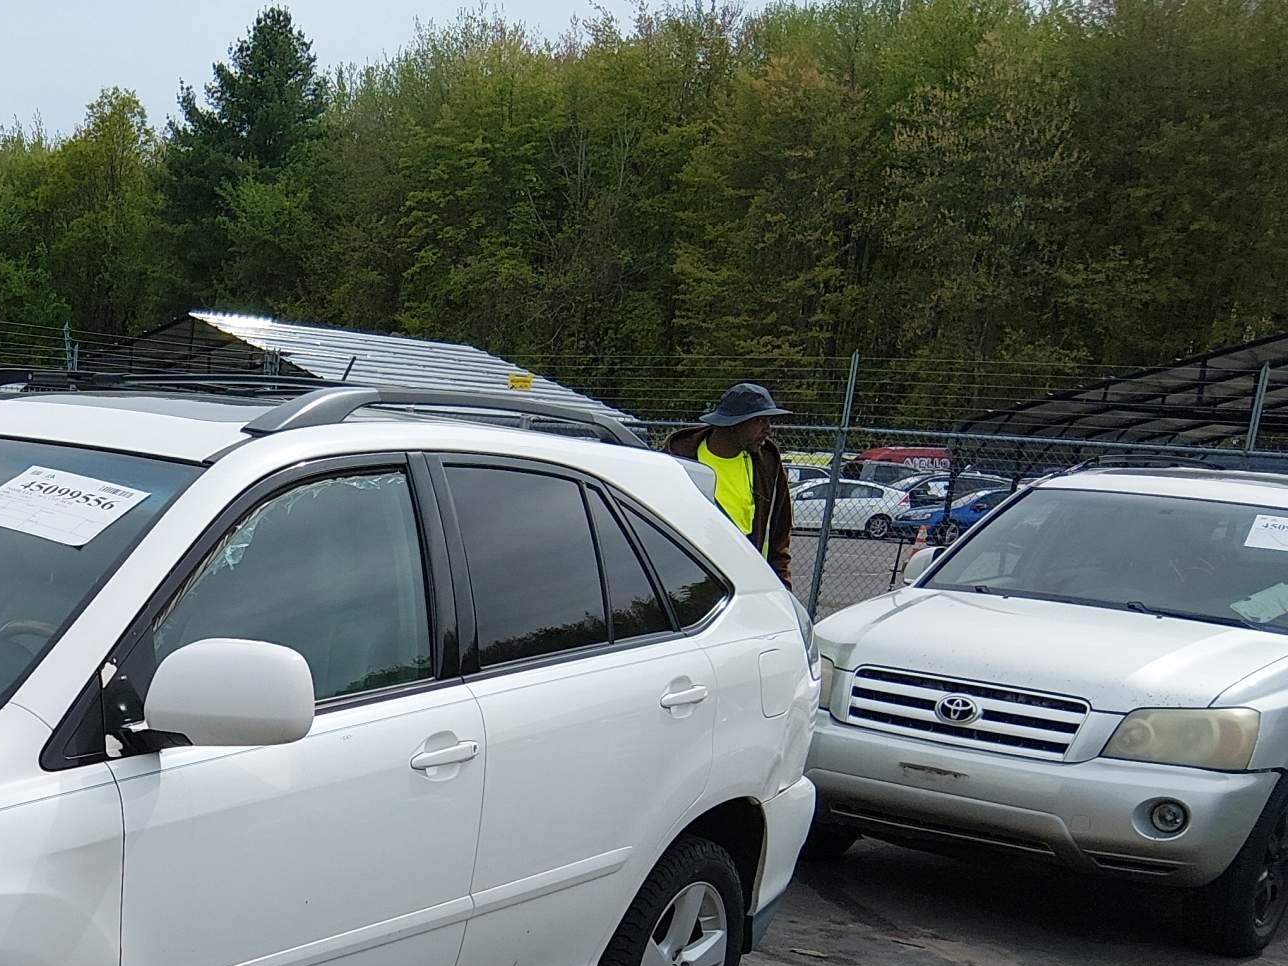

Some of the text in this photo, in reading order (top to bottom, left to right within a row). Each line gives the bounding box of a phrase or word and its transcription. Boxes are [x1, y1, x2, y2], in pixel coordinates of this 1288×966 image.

[904, 457, 951, 469] AIELLO
[19, 481, 121, 510] 45099556
[1261, 523, 1288, 531] 450
